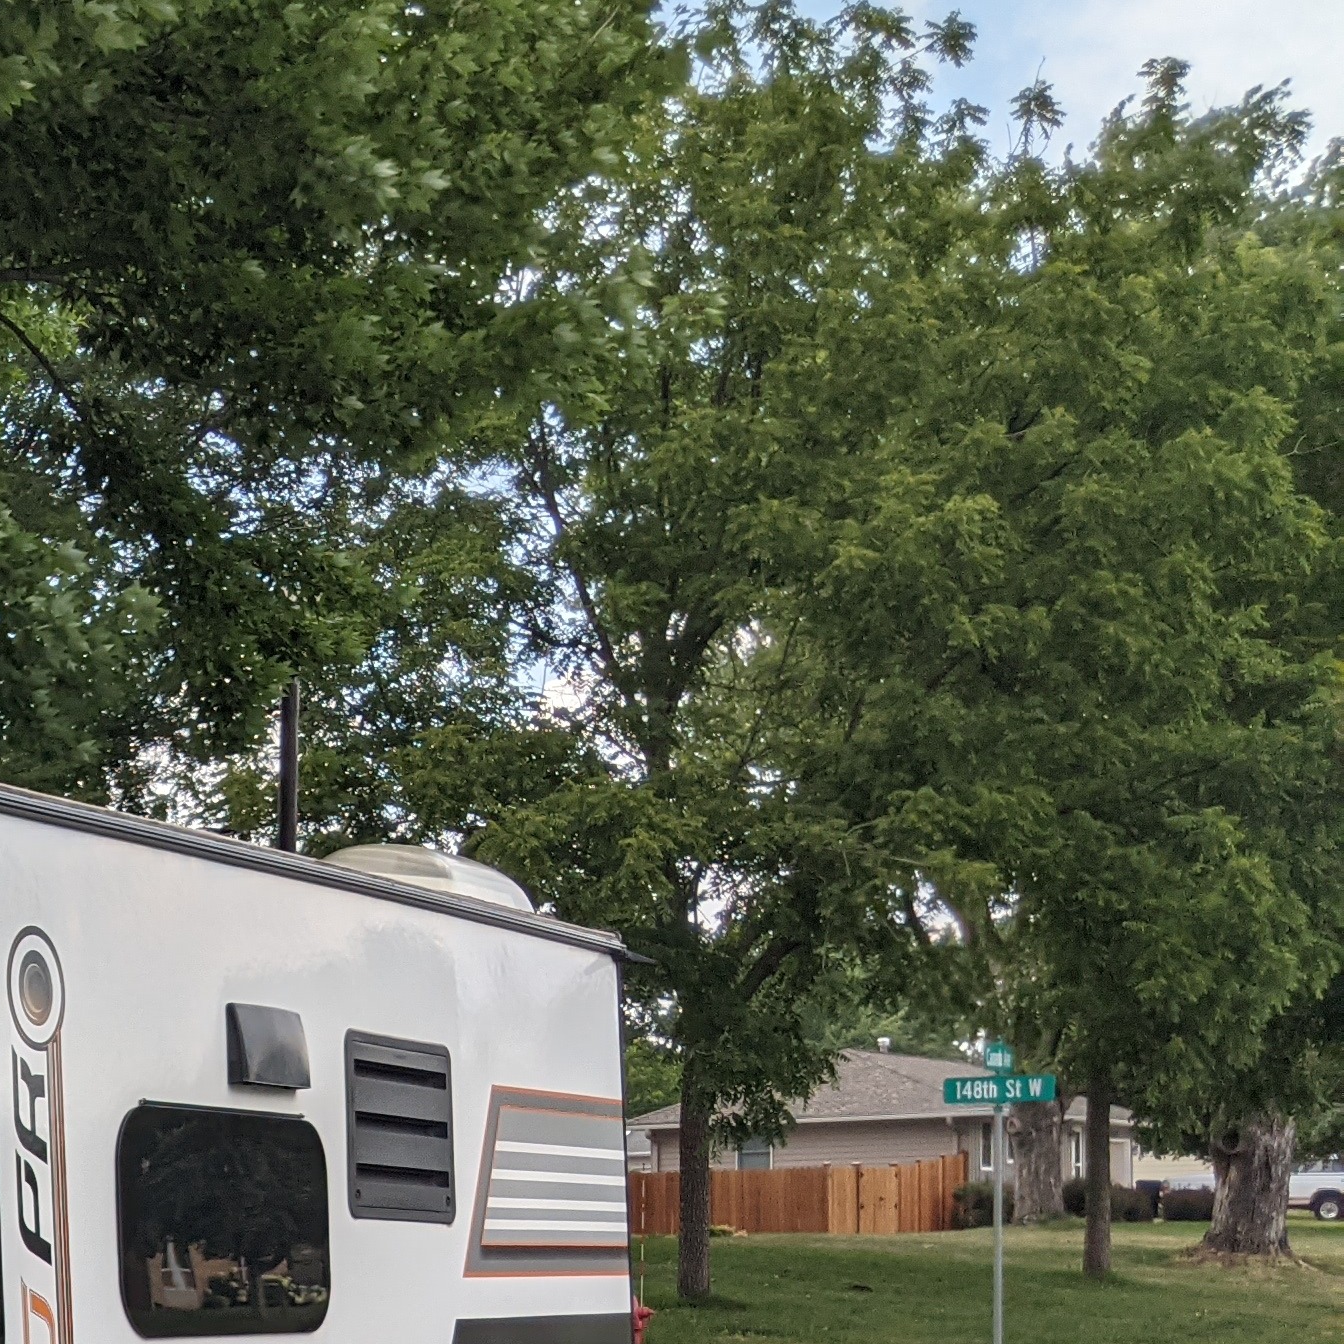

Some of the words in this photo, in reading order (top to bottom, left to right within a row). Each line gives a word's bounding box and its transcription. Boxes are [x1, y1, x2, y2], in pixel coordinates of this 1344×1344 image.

[6, 925, 66, 1267] PRO
[955, 1080, 997, 1100] 148th
[1005, 1079, 1022, 1099] St
[1028, 1078, 1043, 1098] W
